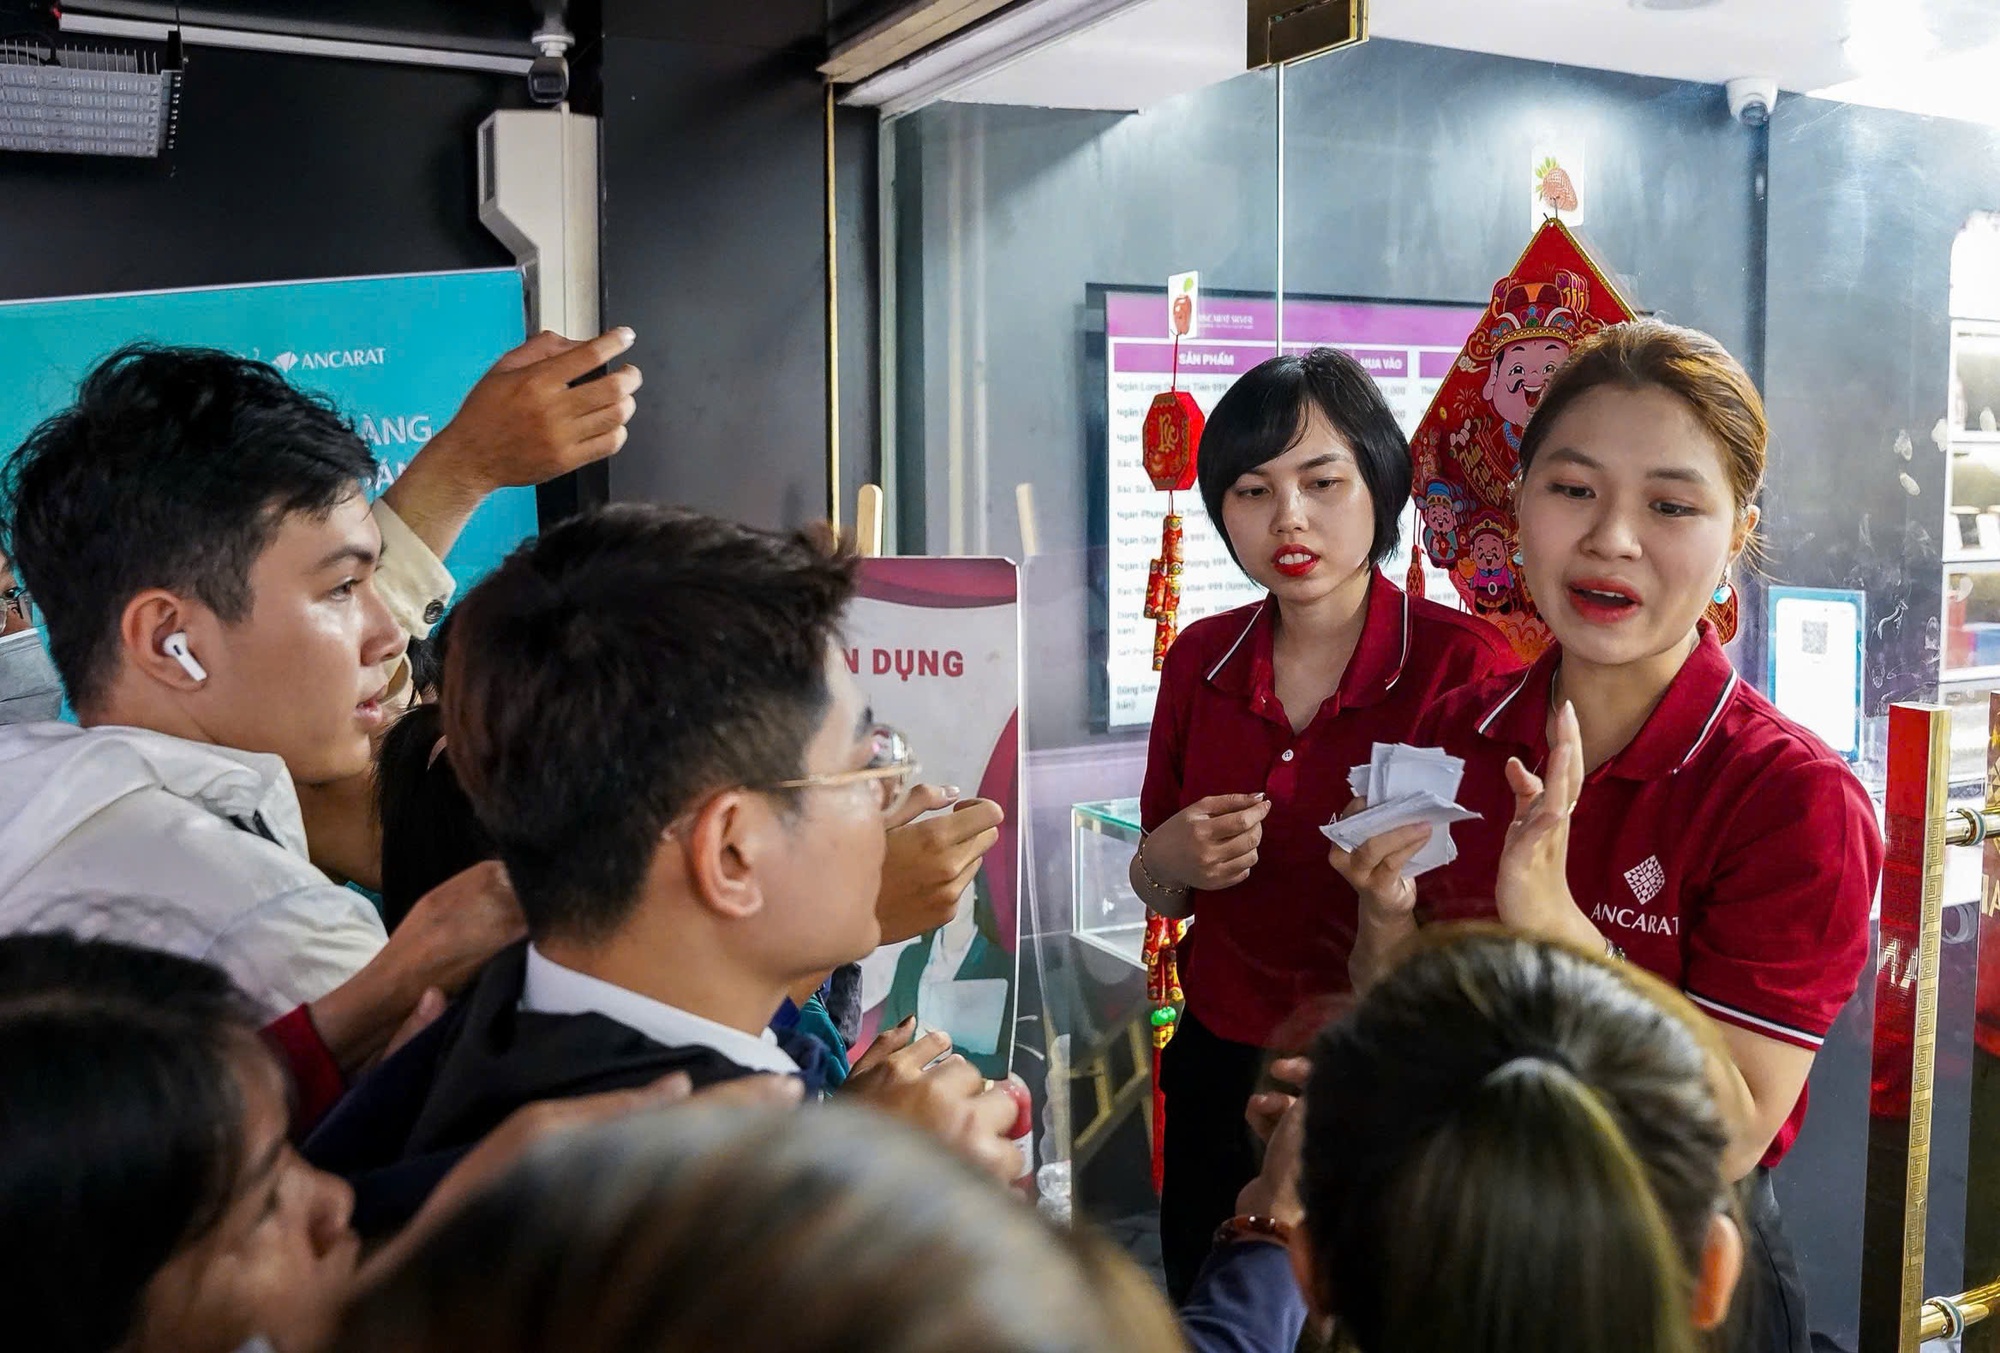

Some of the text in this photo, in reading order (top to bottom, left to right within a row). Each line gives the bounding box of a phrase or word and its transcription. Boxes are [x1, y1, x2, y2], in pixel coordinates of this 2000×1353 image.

[301, 347, 386, 370] ANCARAT
[361, 413, 434, 446] ÀNG
[872, 648, 964, 682] DỤNG
[1590, 902, 1680, 936] ANCARAT
